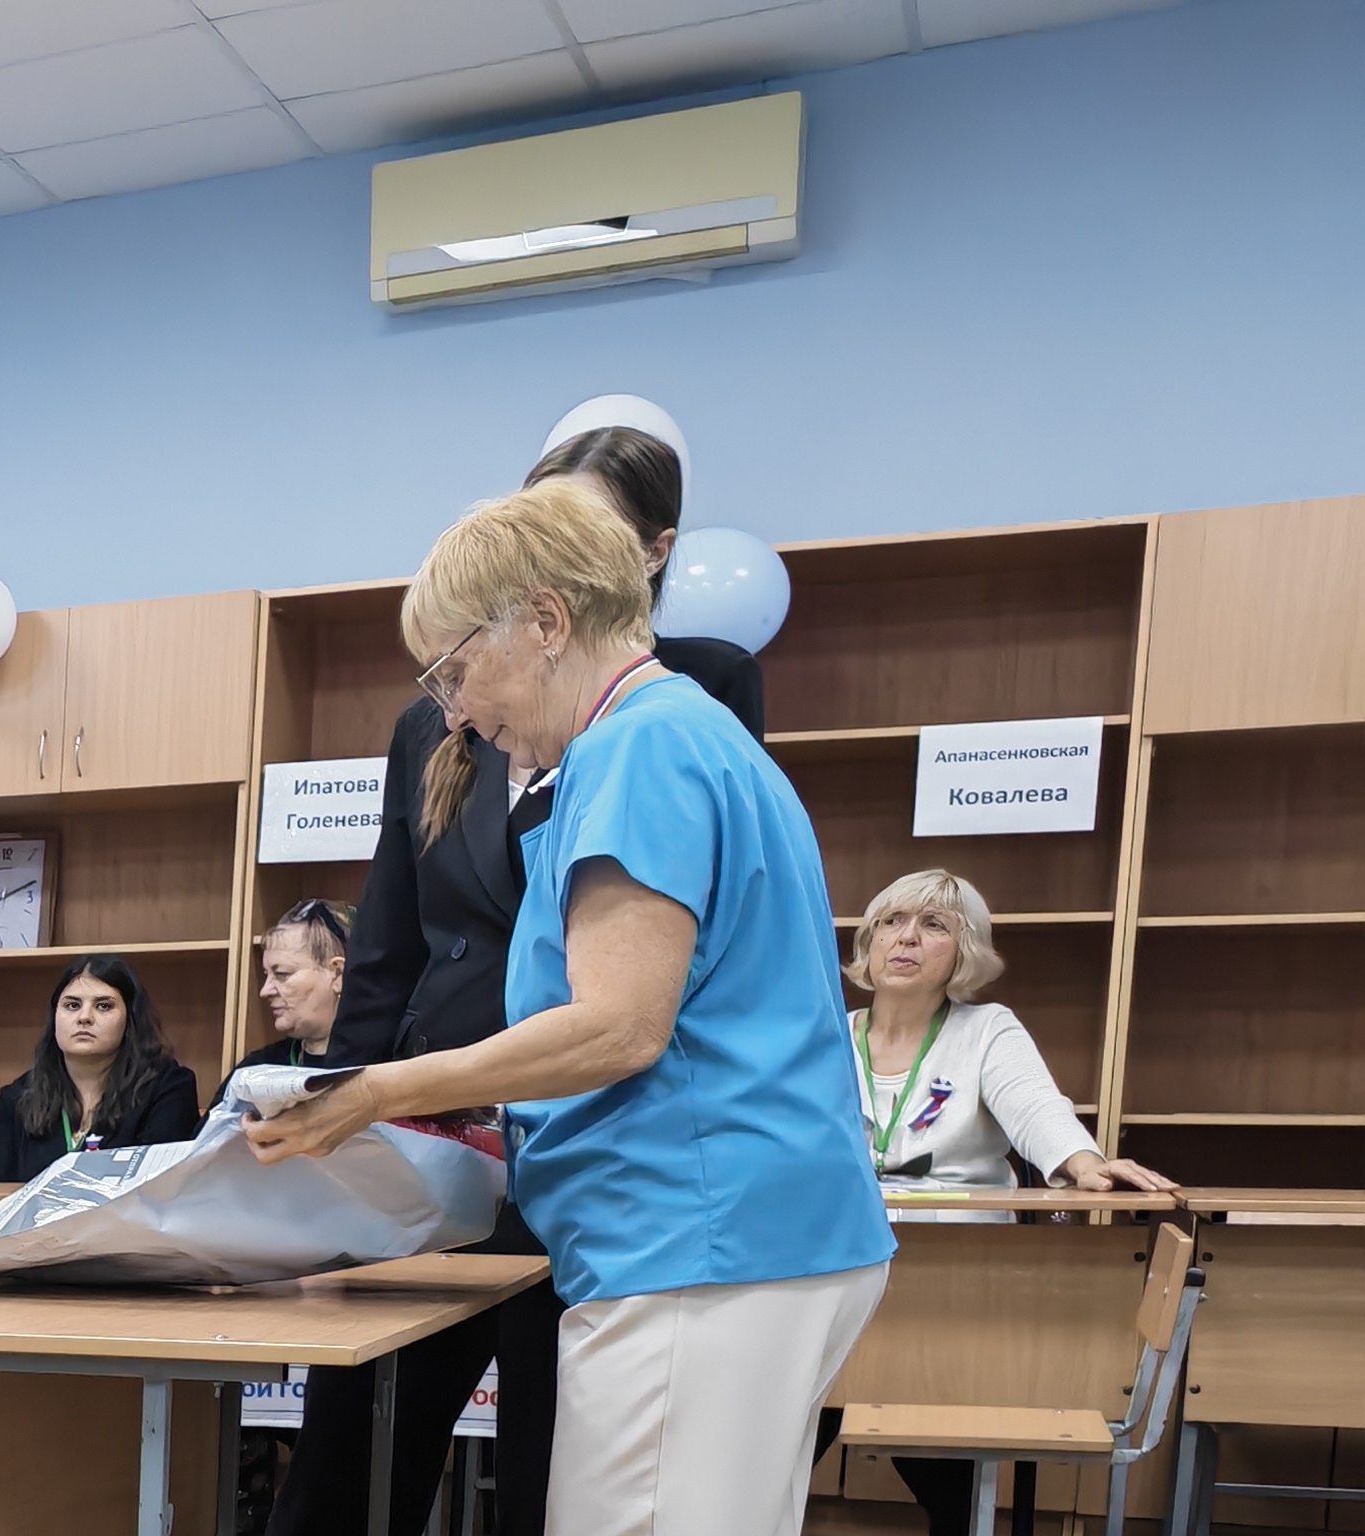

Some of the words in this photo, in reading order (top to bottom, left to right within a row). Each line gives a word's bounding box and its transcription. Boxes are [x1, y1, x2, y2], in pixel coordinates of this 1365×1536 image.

[934, 745, 1089, 763] Апанасенковская
[294, 778, 379, 796] Ипатова
[949, 787, 1068, 806] Ковалева
[286, 813, 383, 830] Голенева
